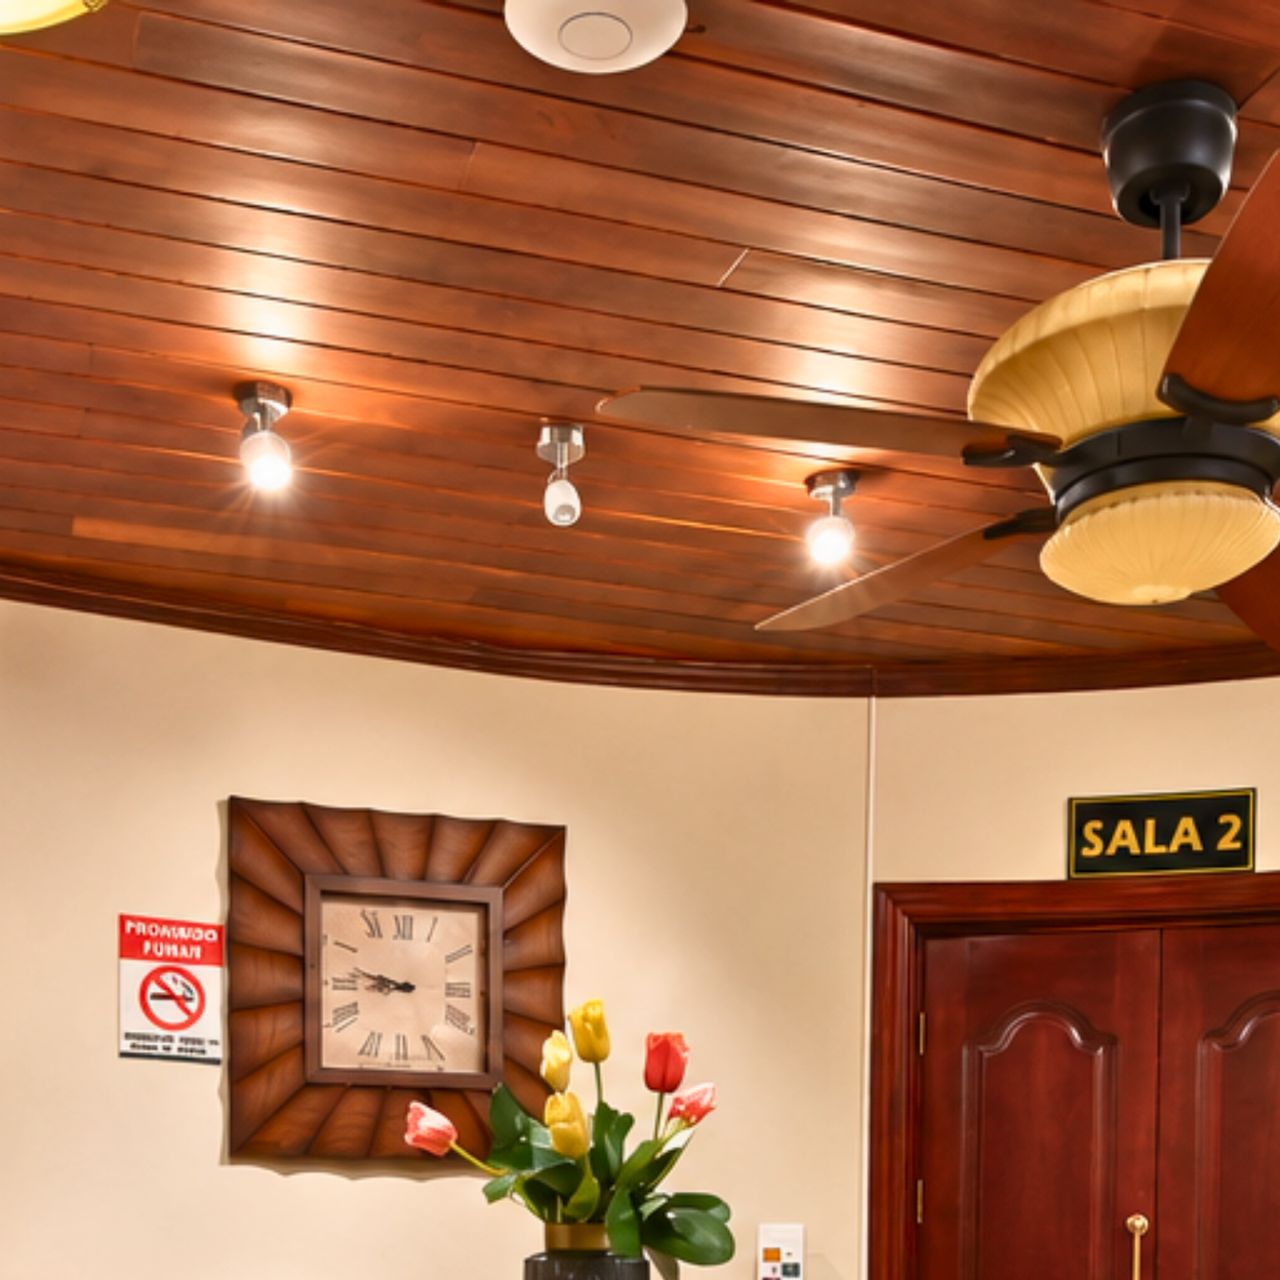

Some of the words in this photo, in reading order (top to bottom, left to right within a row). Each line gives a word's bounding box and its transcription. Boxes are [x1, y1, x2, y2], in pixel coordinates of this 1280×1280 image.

[1080, 815, 1204, 858] SALA
[1215, 813, 1243, 852] 2
[143, 939, 202, 960] FUMAR
